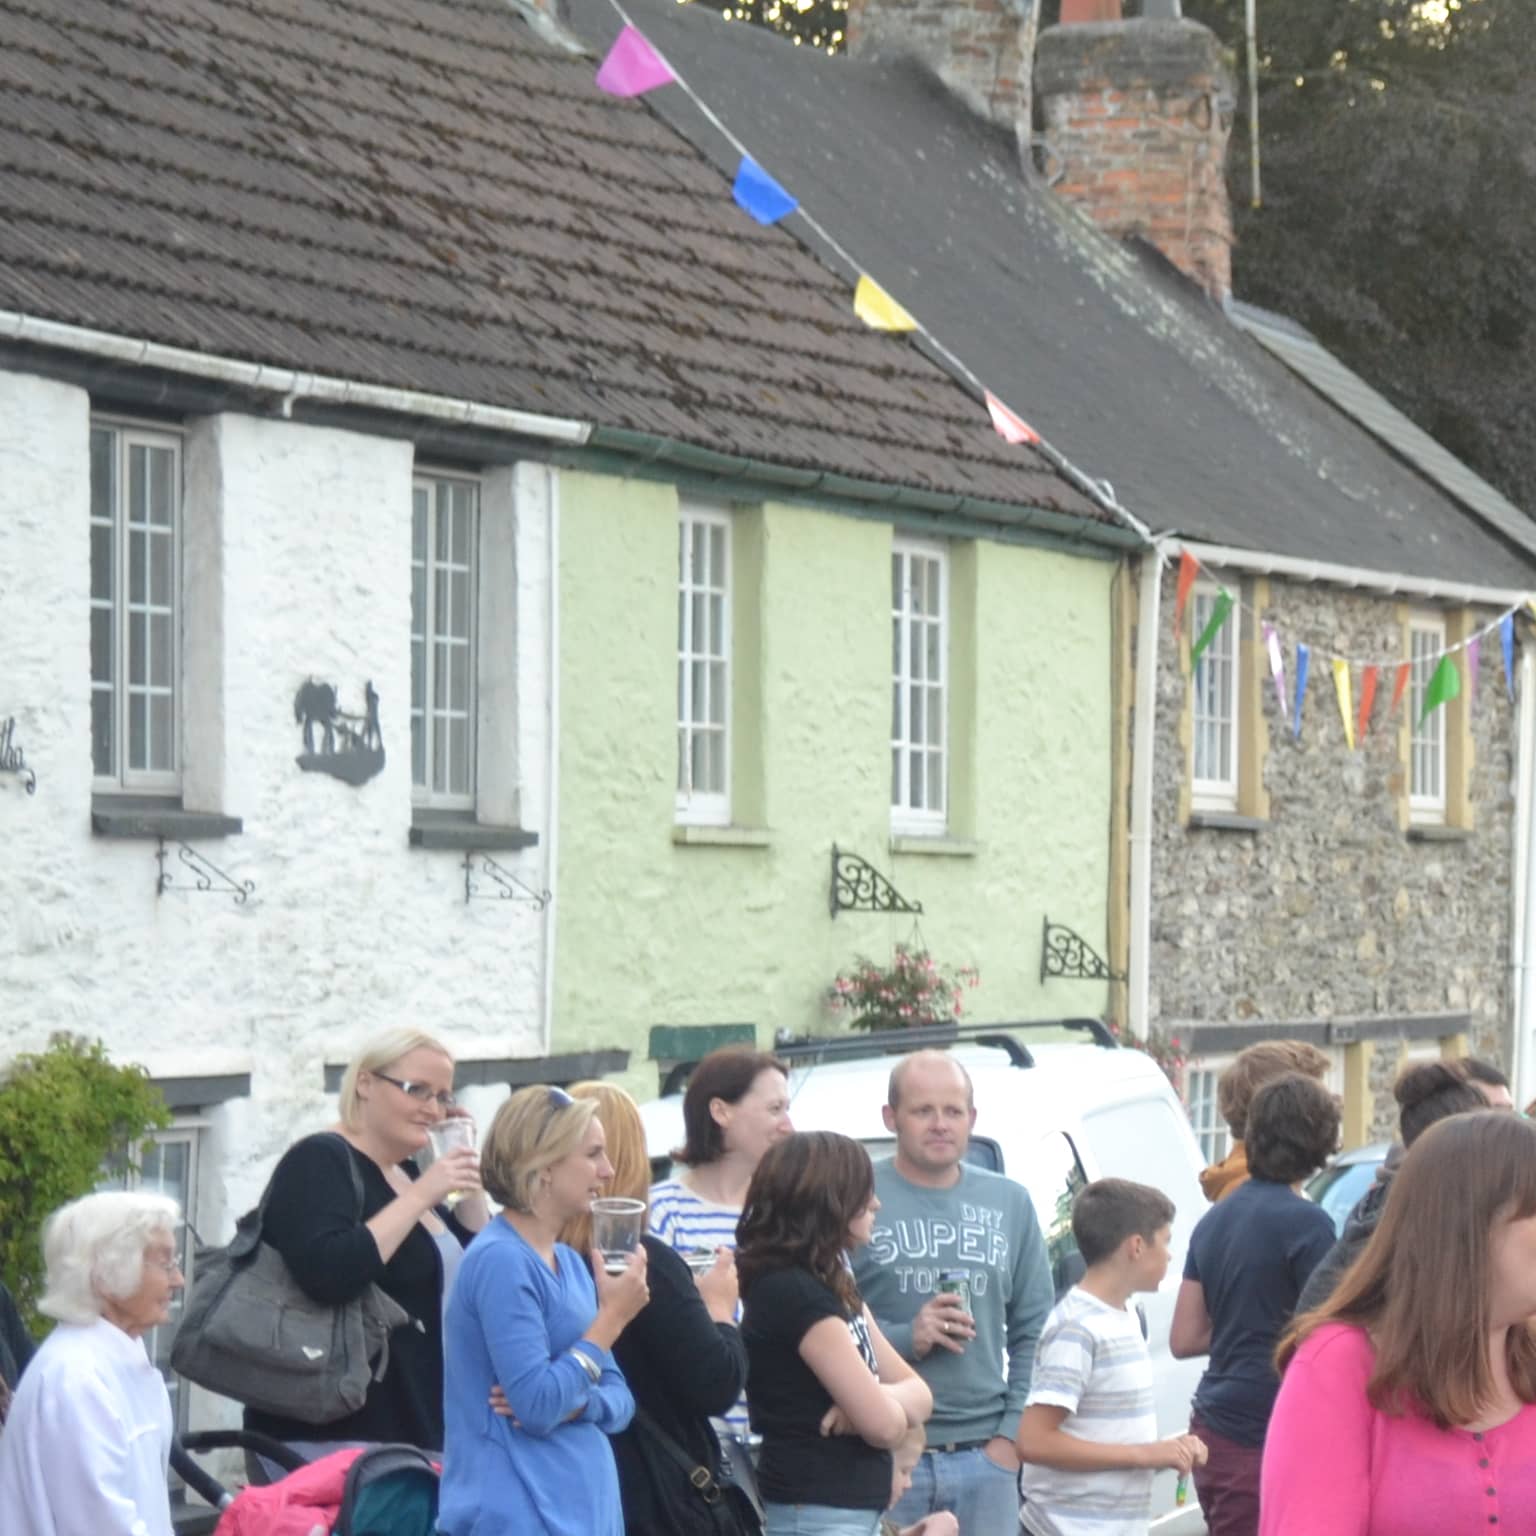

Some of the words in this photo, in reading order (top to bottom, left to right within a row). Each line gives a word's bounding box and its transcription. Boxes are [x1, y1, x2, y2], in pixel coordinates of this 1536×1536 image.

[962, 1202, 1003, 1229] DRY
[868, 1218, 1009, 1271] SUPER
[894, 1265, 988, 1297] TOO
